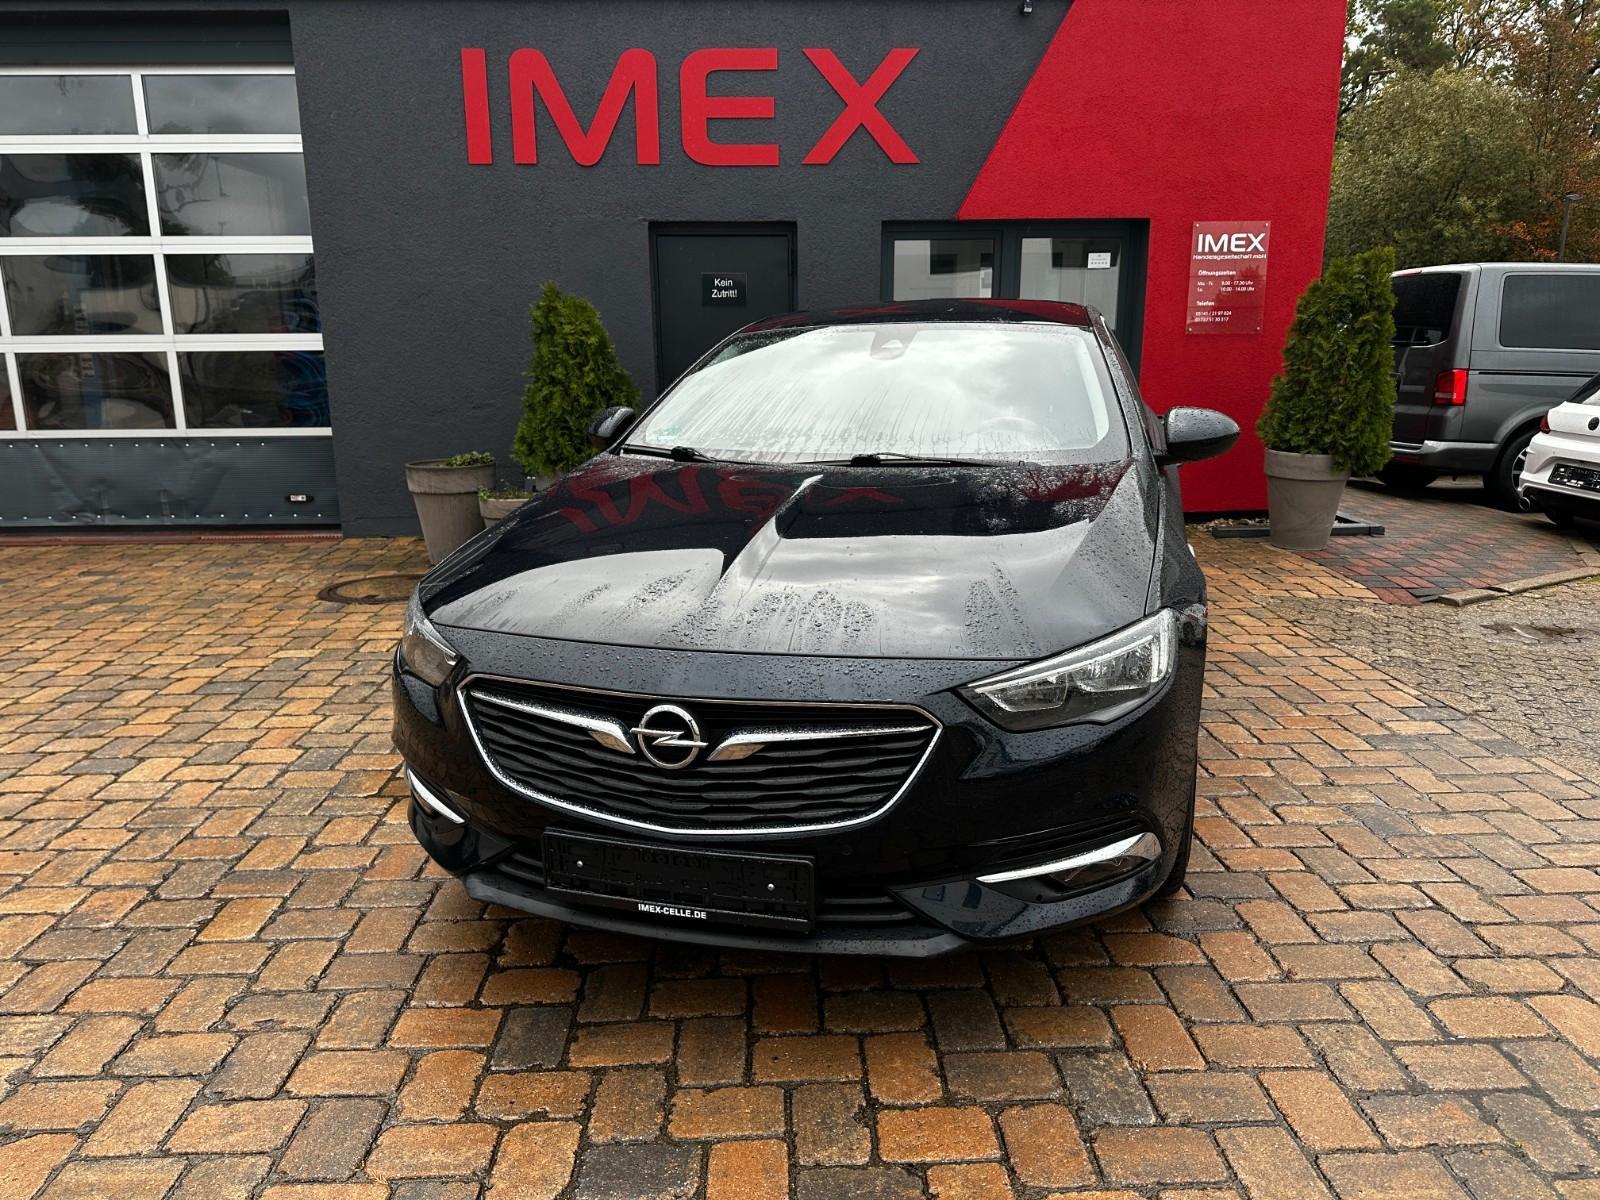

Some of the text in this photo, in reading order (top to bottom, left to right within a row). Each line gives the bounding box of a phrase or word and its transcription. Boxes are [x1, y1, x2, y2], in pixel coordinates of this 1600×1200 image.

[461, 47, 921, 167] IMEX
[1197, 233, 1266, 252] IMEX
[714, 277, 733, 287] Kein
[711, 288, 738, 298] Zutritt!
[637, 903, 707, 919] IMEX-CELLE.DE
